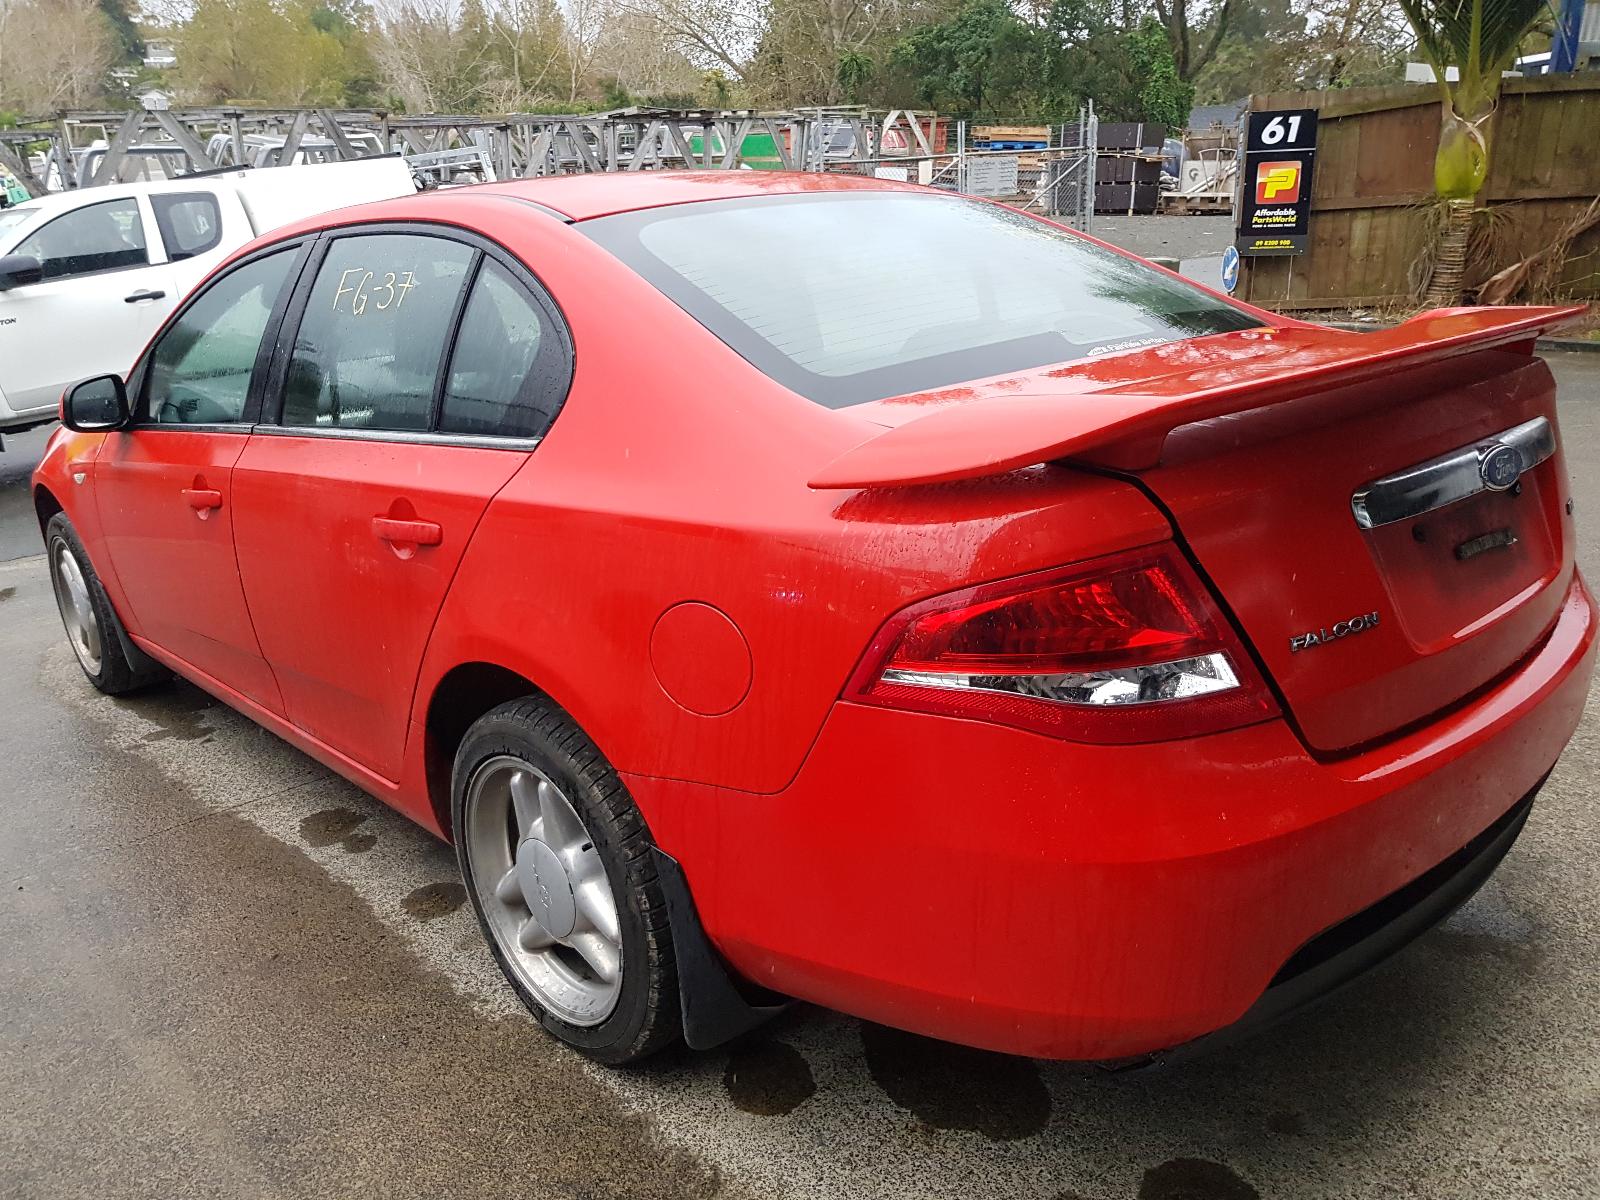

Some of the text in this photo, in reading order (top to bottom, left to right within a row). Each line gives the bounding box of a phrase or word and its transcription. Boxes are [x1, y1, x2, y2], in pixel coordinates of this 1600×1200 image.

[1260, 115, 1302, 145] 61
[1251, 215, 1298, 224] PartsWorld
[1253, 208, 1297, 217] Affordable
[333, 267, 414, 316] FG-37
[1289, 611, 1379, 652] FALCON
